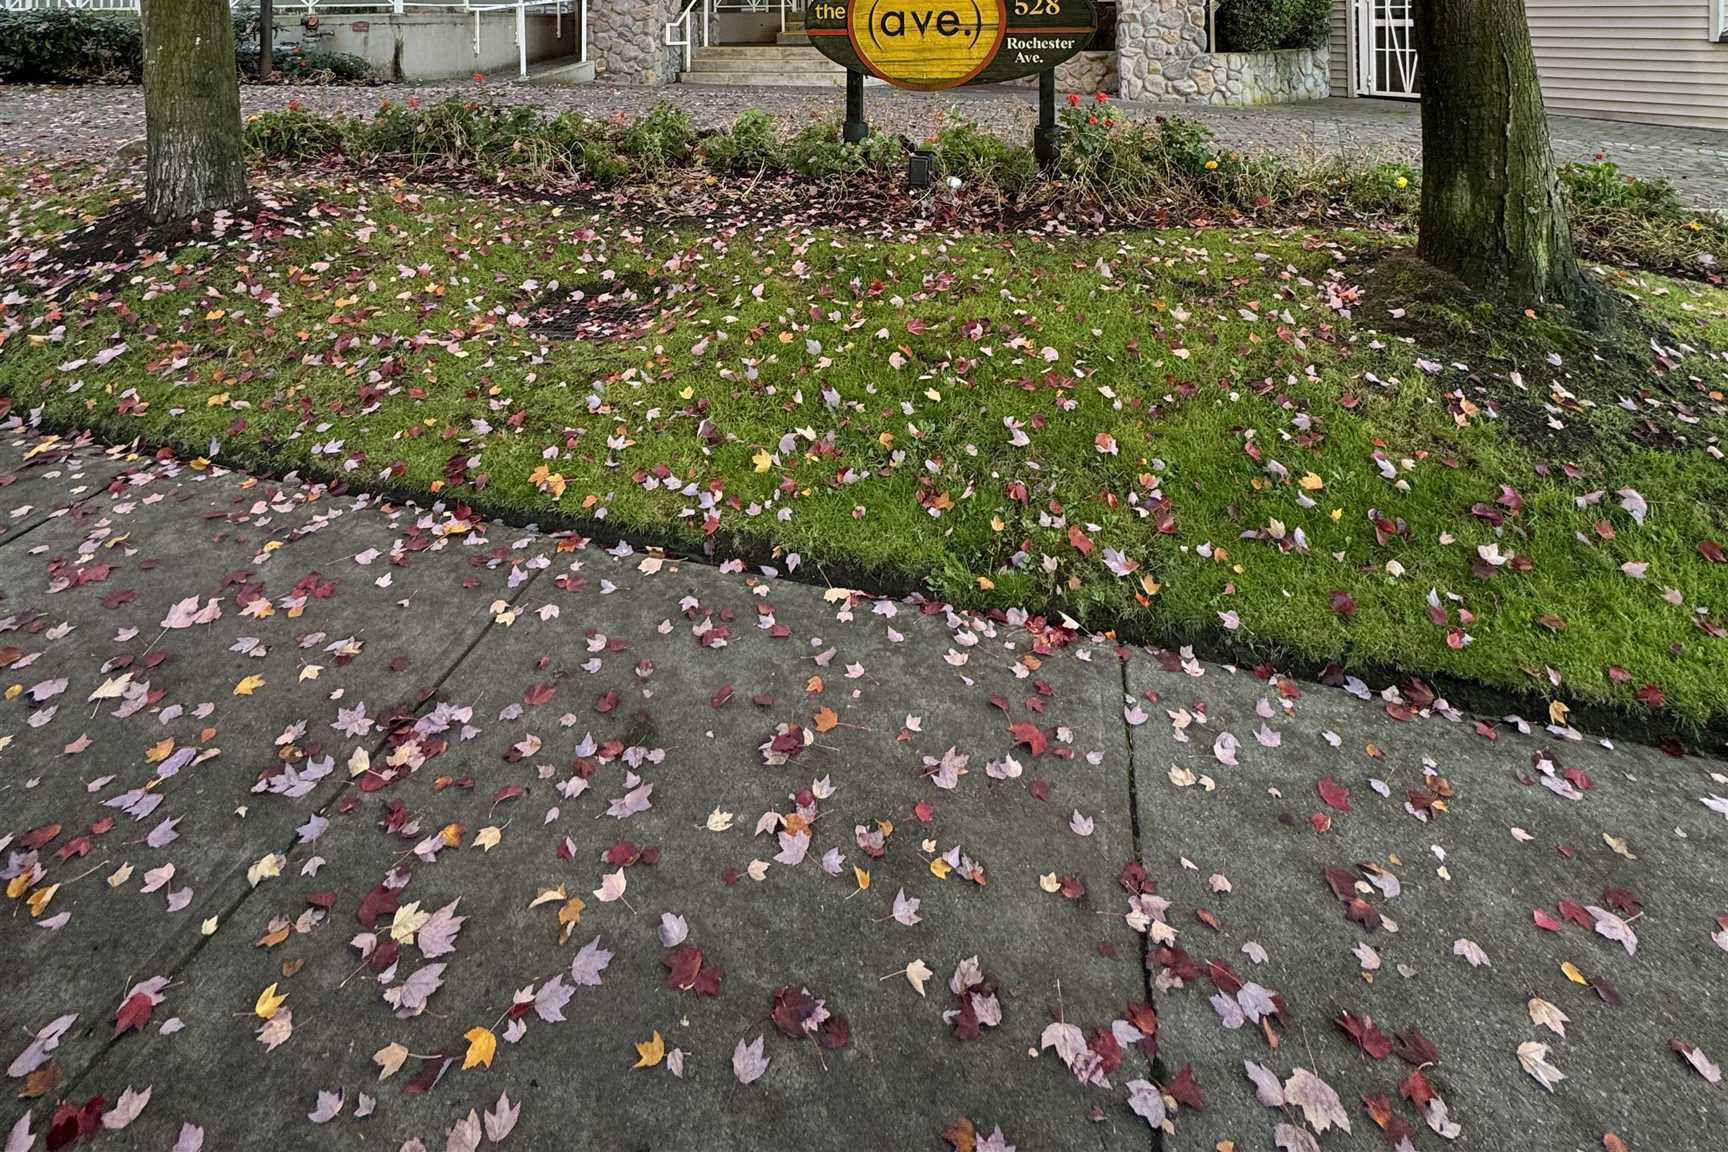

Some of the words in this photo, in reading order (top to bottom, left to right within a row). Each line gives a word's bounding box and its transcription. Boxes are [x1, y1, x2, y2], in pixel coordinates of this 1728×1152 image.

[815, 3, 846, 20] the
[1007, 37, 1075, 50] Rochester
[1015, 52, 1044, 64] Ave.
